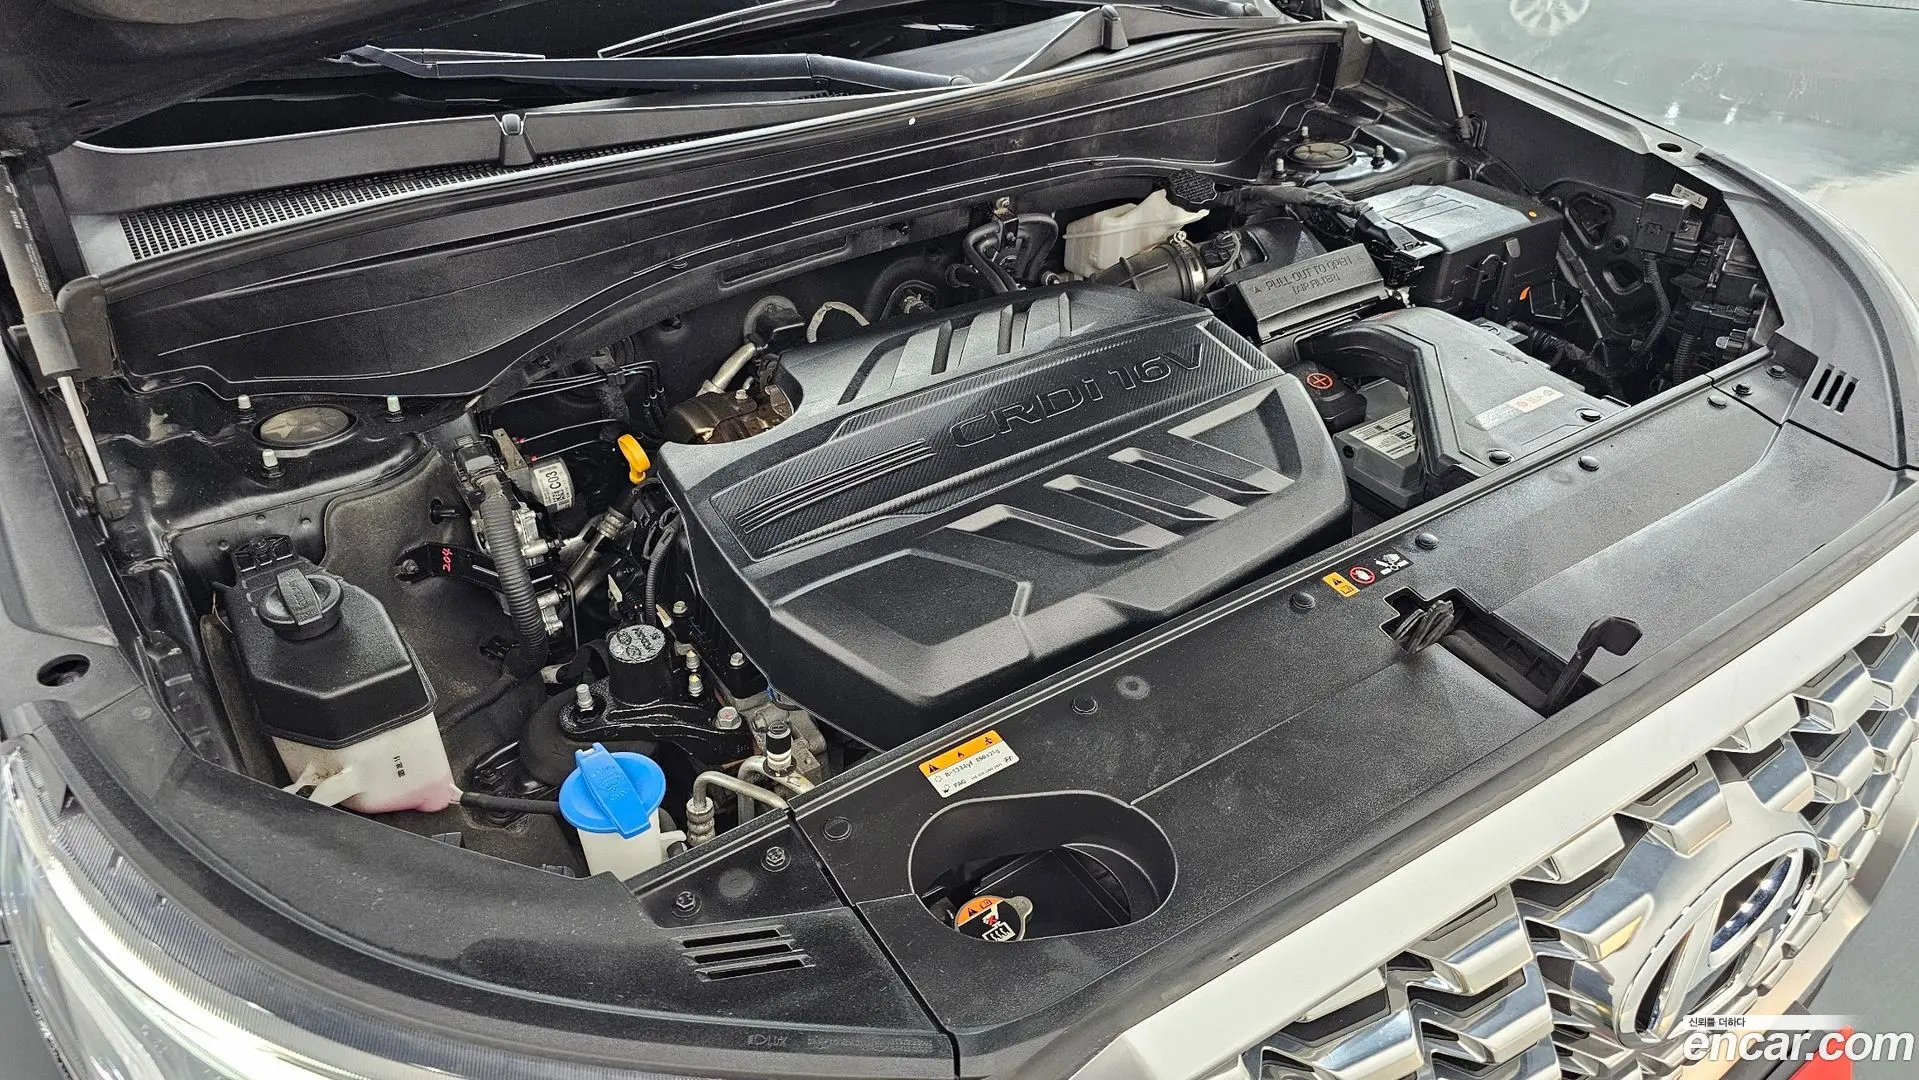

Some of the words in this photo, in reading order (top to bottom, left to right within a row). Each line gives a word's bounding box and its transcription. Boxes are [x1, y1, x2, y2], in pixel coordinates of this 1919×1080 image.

[1265, 275, 1293, 291] PULL
[1292, 267, 1313, 283] OUT
[1313, 263, 1327, 277] TO
[1327, 256, 1353, 272] OPEN
[950, 378, 1104, 448] CRDi
[1108, 342, 1203, 391] 16V
[442, 548, 453, 572] 204
[953, 779, 967, 789] PAG
